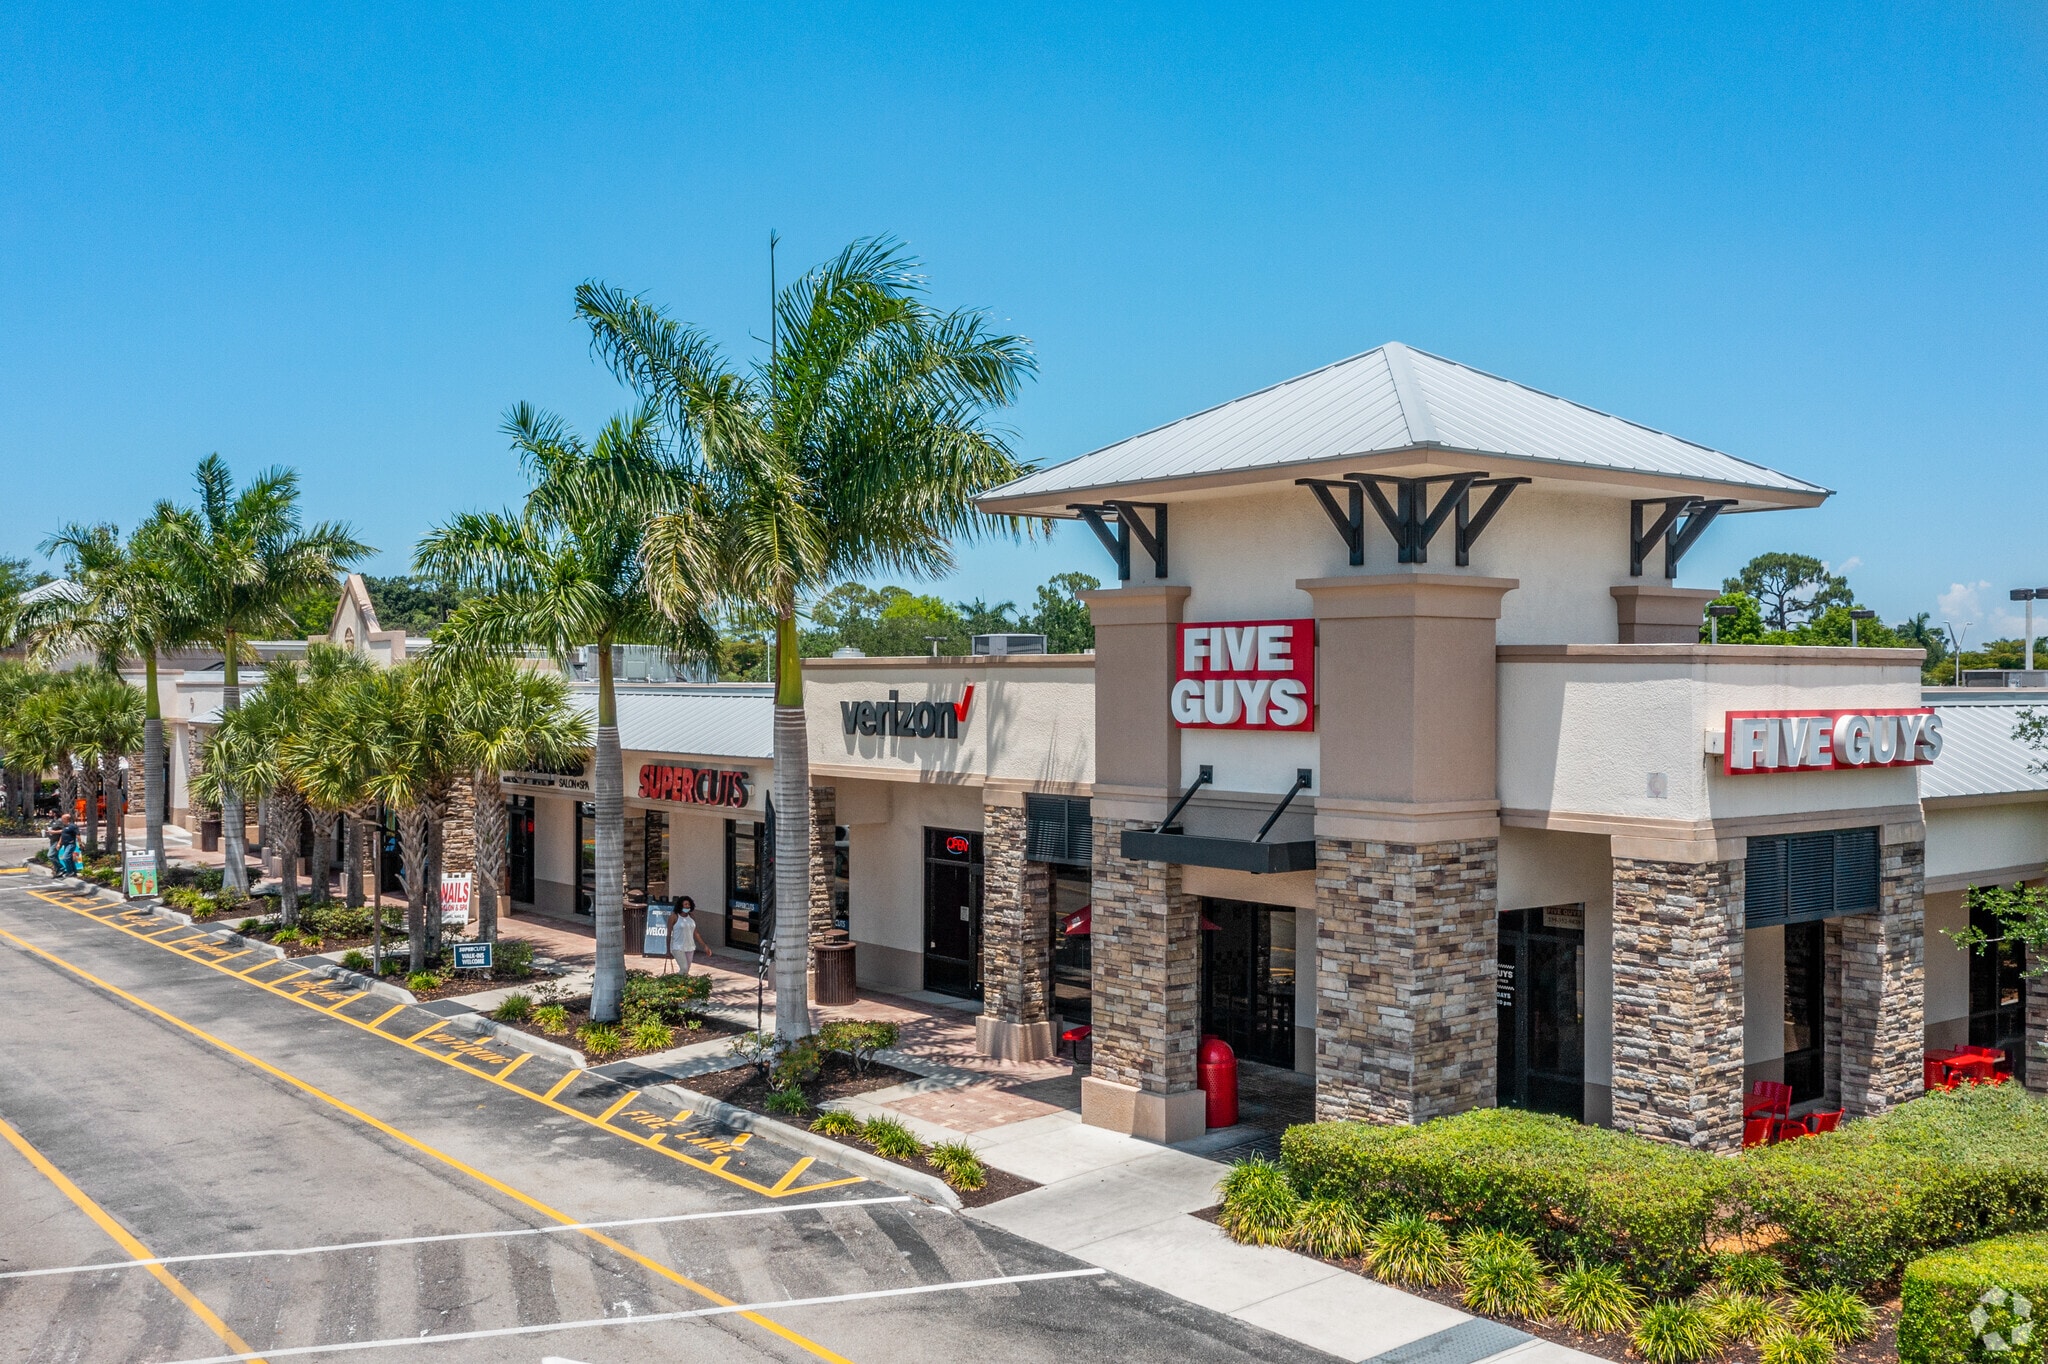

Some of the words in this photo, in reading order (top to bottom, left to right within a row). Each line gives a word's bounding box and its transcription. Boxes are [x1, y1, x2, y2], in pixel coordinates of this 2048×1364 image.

[1184, 625, 1294, 672] FIVE
[840, 689, 959, 740] verizon
[1171, 678, 1308, 727] GUYS
[1731, 716, 1833, 770] FIVE
[1833, 713, 1944, 766] GUYS
[638, 764, 750, 809] SUPERCUTS
[946, 837, 969, 853] OPEN
[441, 882, 470, 904] NAILS
[1497, 969, 1514, 979] UYS
[620, 1110, 679, 1129] FIRE
[674, 1131, 745, 1155] LANE
